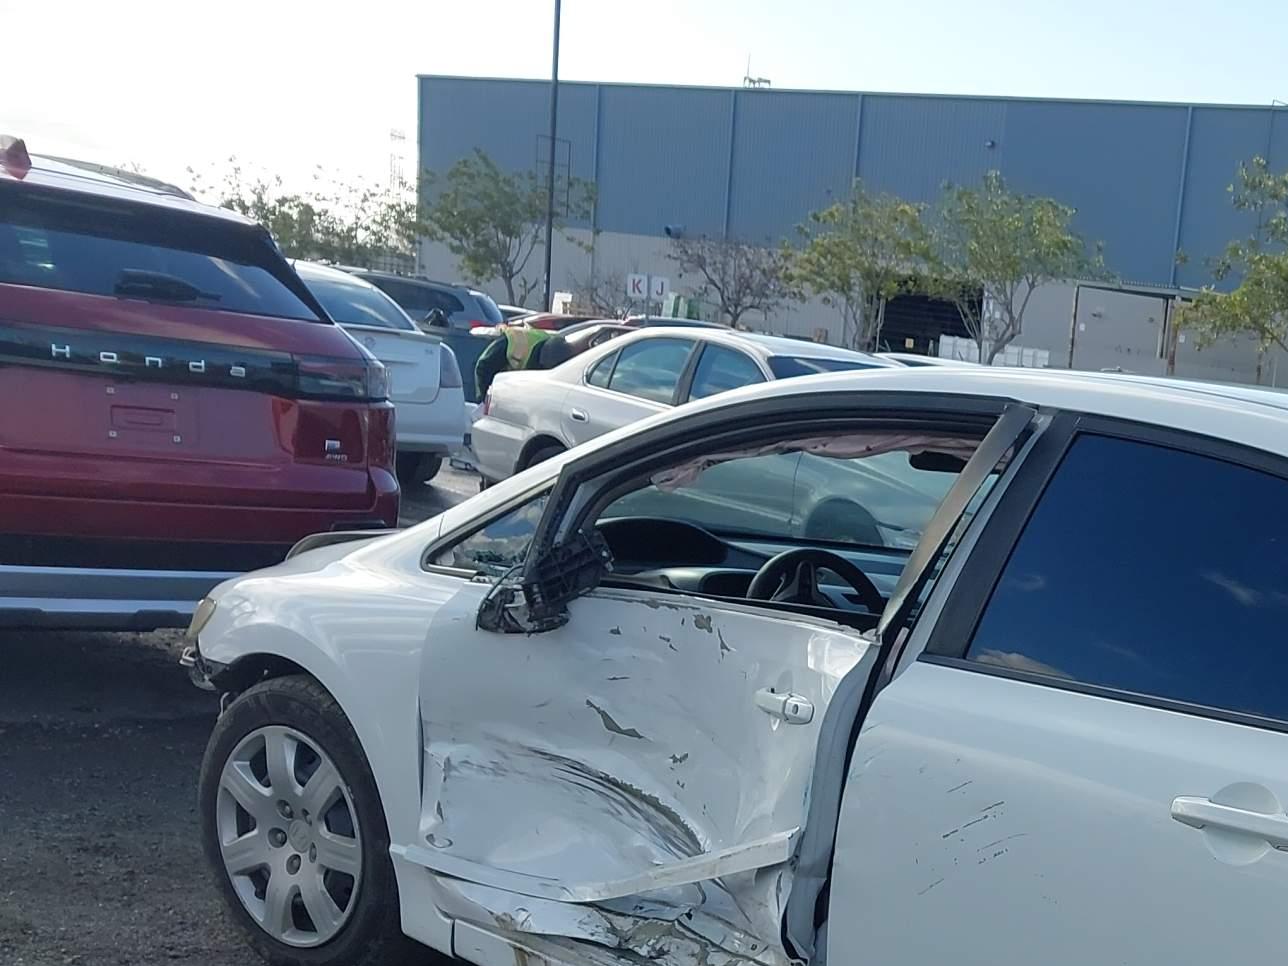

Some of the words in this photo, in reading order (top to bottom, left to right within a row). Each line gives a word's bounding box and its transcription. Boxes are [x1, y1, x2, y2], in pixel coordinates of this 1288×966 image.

[632, 278, 642, 295] K
[656, 281, 665, 296] J
[51, 343, 246, 378] Honda
